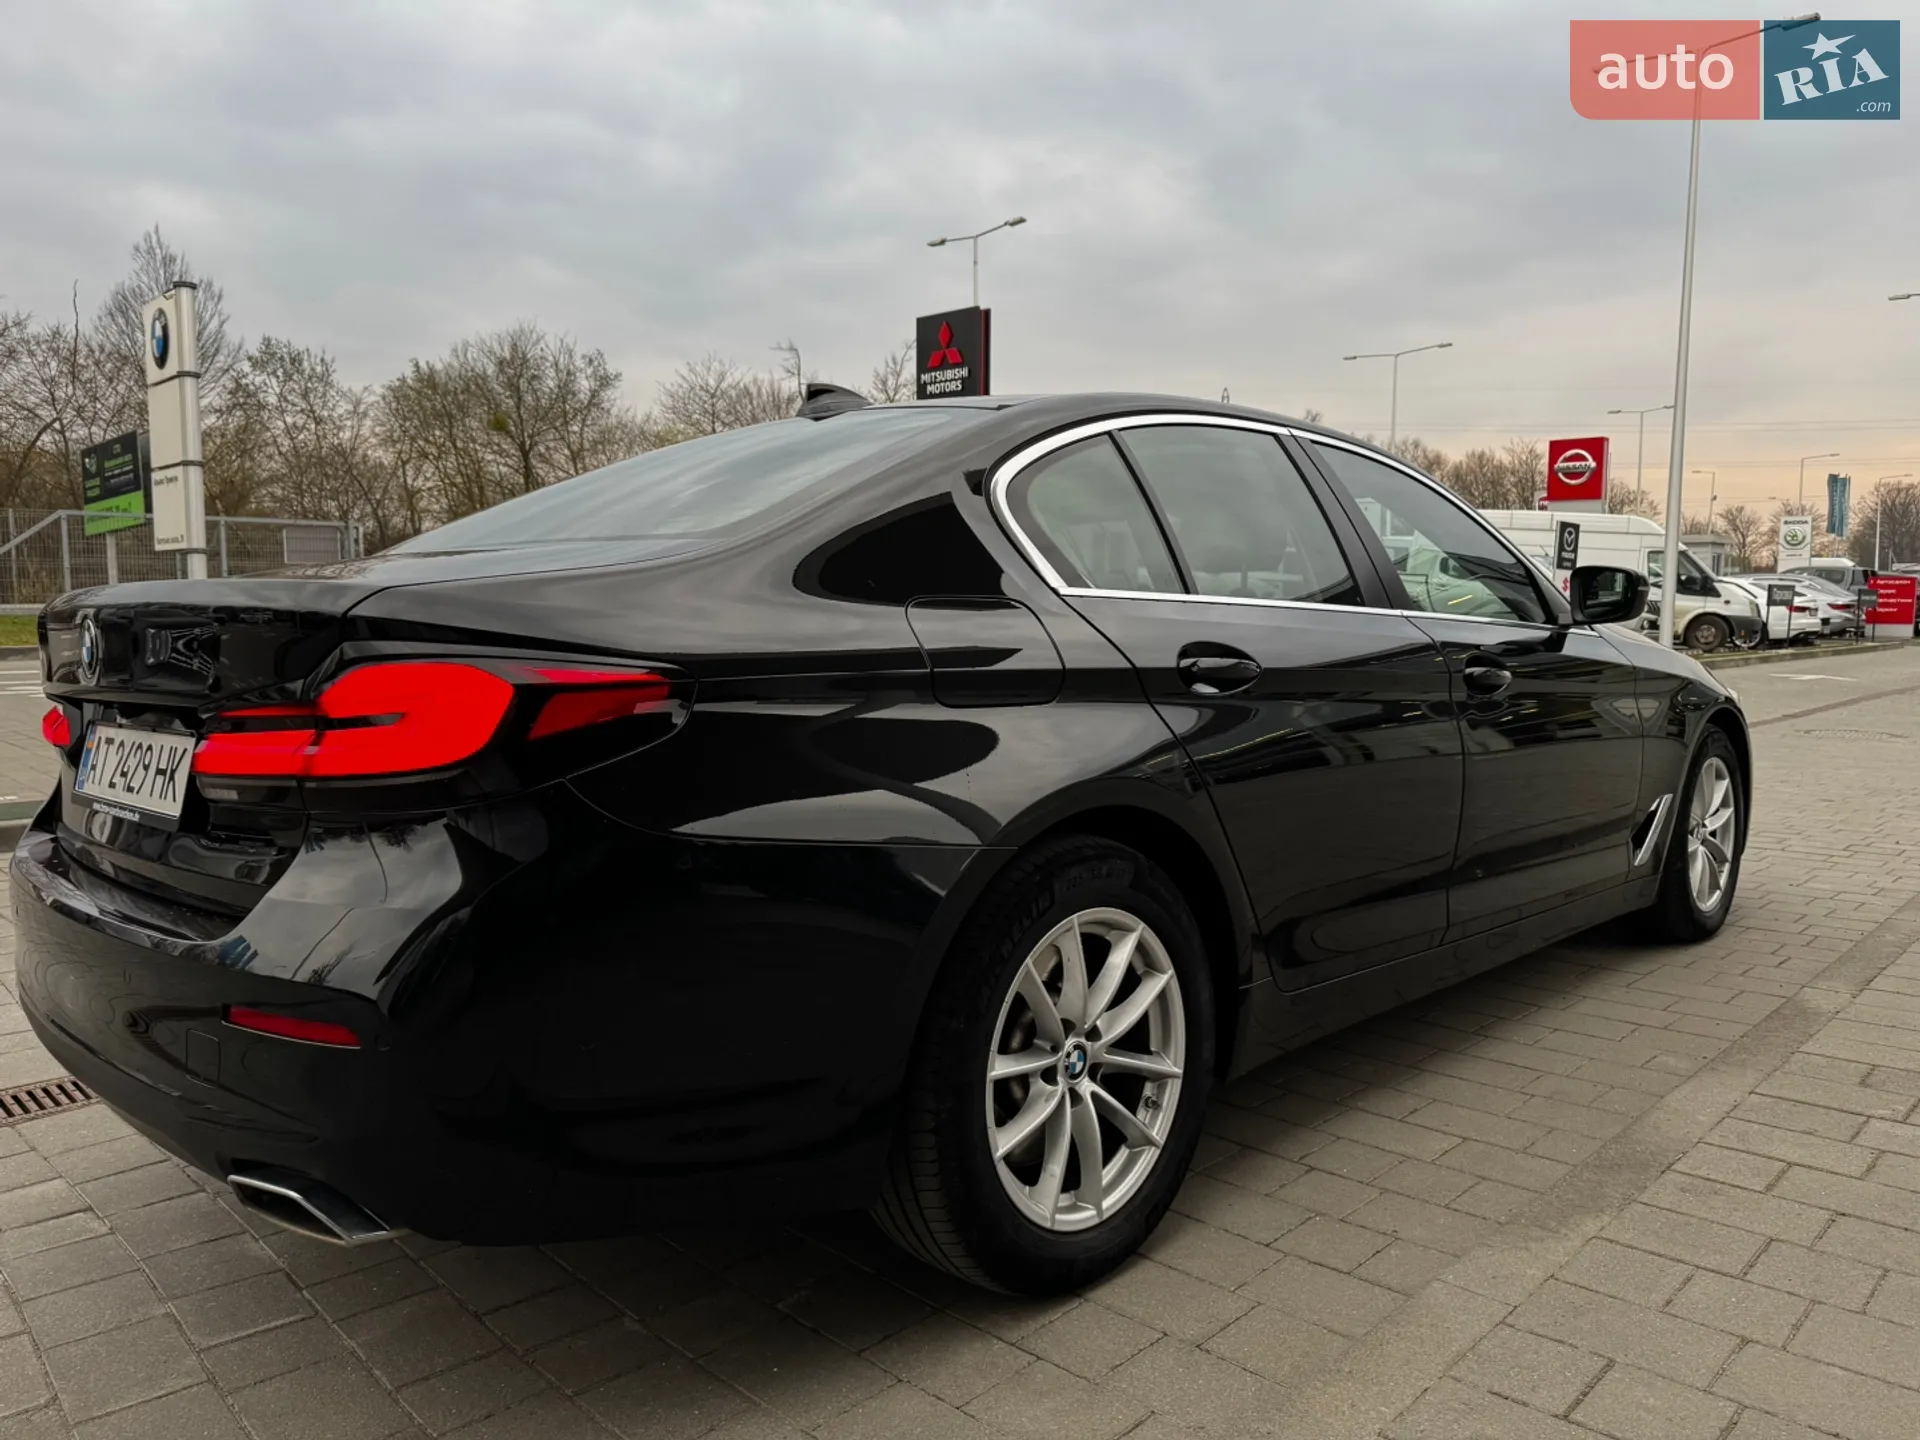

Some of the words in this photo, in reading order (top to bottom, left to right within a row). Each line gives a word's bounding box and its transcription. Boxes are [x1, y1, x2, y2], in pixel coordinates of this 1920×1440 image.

[920, 366, 969, 384] MITSUBISHI
[926, 380, 963, 395] MOTORS
[1556, 462, 1593, 472] NISSAN
[86, 735, 115, 786] AT
[108, 738, 154, 795] 2429
[149, 743, 188, 803] HK
